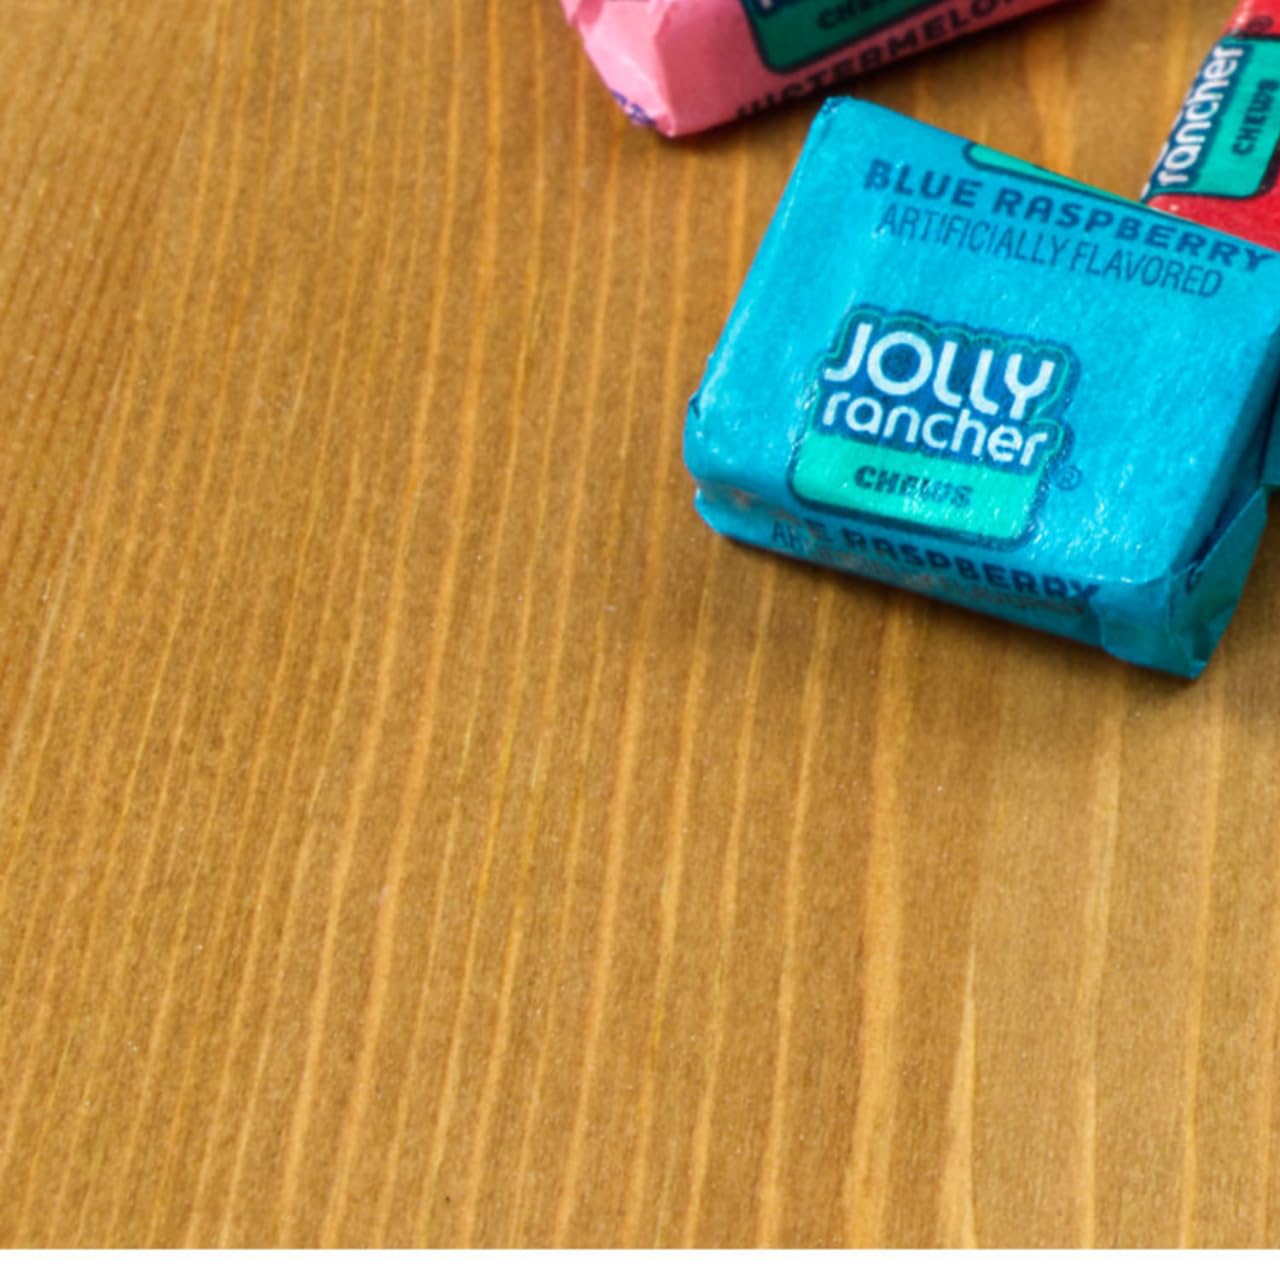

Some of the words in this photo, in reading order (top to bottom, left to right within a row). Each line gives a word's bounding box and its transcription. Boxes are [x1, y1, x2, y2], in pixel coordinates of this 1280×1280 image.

[1158, 45, 1244, 186] rancher
[863, 159, 983, 208] BLUE
[991, 186, 1277, 273] RASPBERRY
[876, 202, 1070, 266] ARTIFICIALLY
[1070, 240, 1224, 298] FLAVORED
[823, 322, 1055, 420] JOLLY
[822, 391, 1048, 466] rancher
[854, 465, 975, 508] CHEWS
[840, 528, 1101, 605] RASPBERRY
